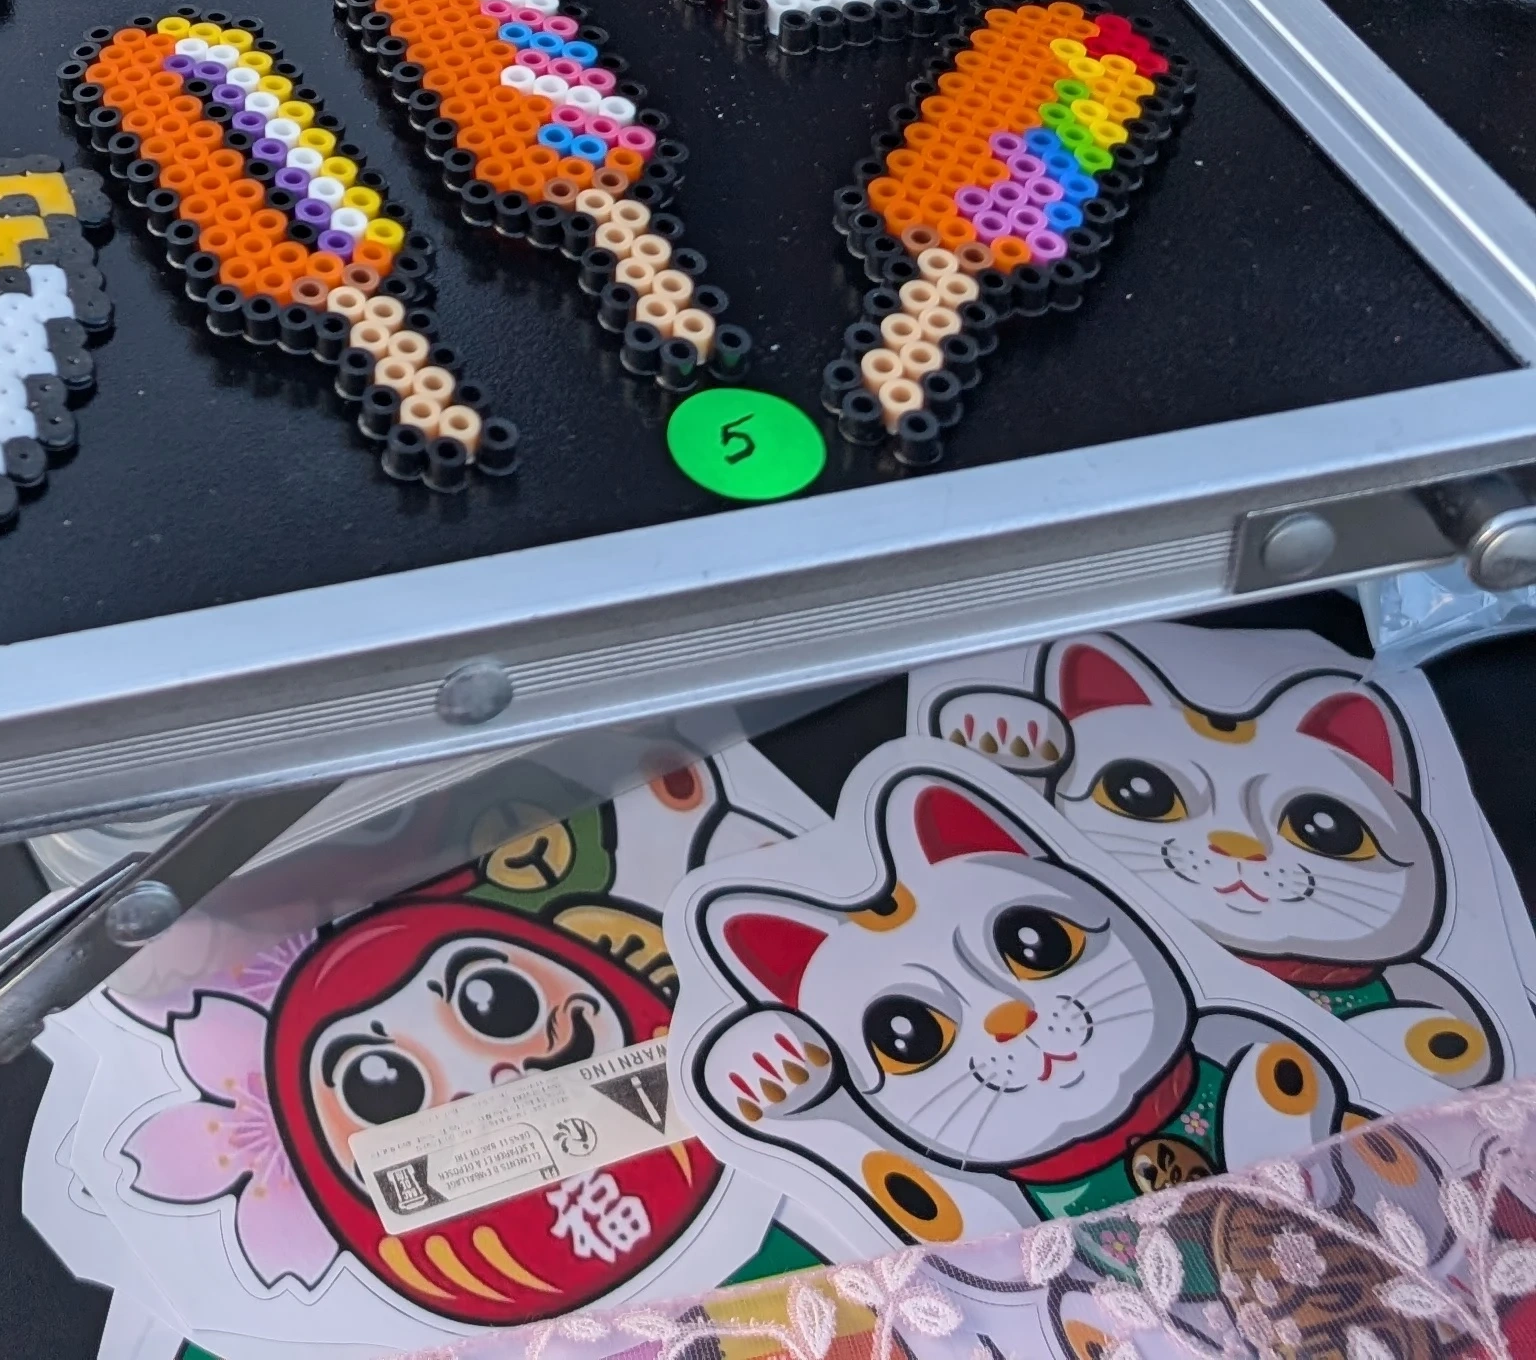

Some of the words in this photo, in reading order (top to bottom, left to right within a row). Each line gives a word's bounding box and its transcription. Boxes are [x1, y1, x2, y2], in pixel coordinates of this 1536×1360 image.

[720, 412, 755, 464] 5
[578, 1042, 668, 1082] WARNING
[546, 1170, 651, 1263] 福
